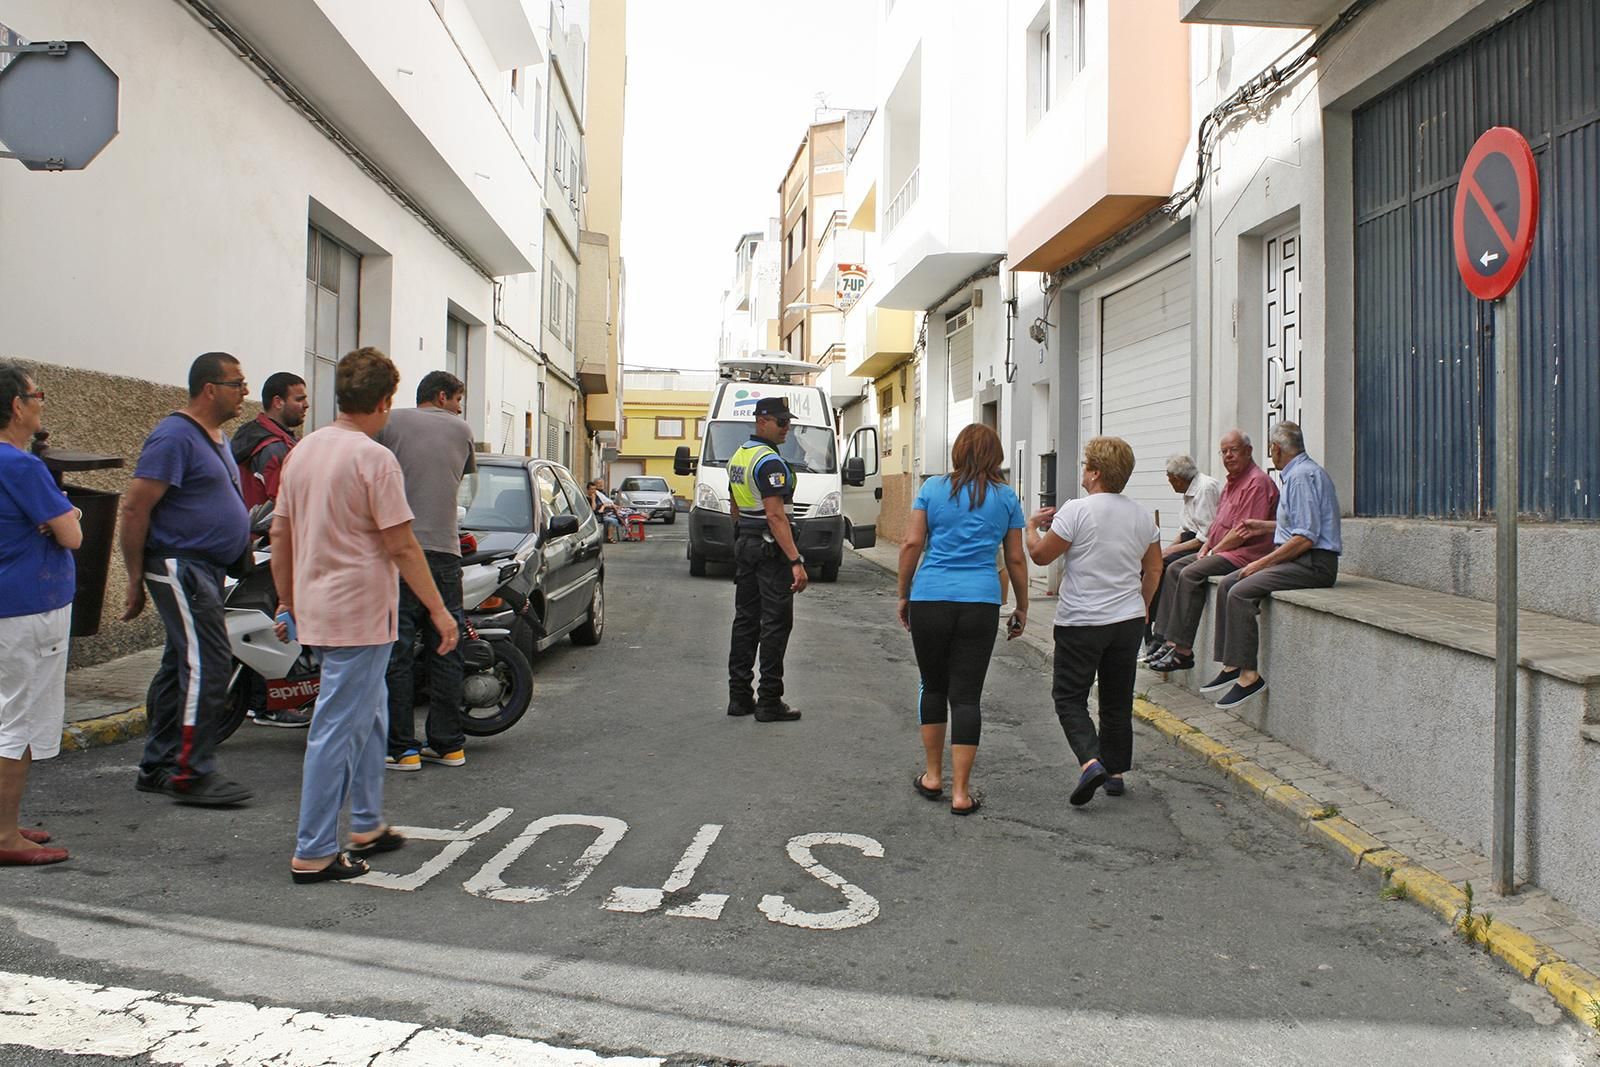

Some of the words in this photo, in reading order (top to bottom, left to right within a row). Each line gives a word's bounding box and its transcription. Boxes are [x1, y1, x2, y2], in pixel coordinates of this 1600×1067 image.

[733, 409, 753, 417] BRE
[268, 680, 321, 700] aprilia
[339, 806, 886, 931] STOP
